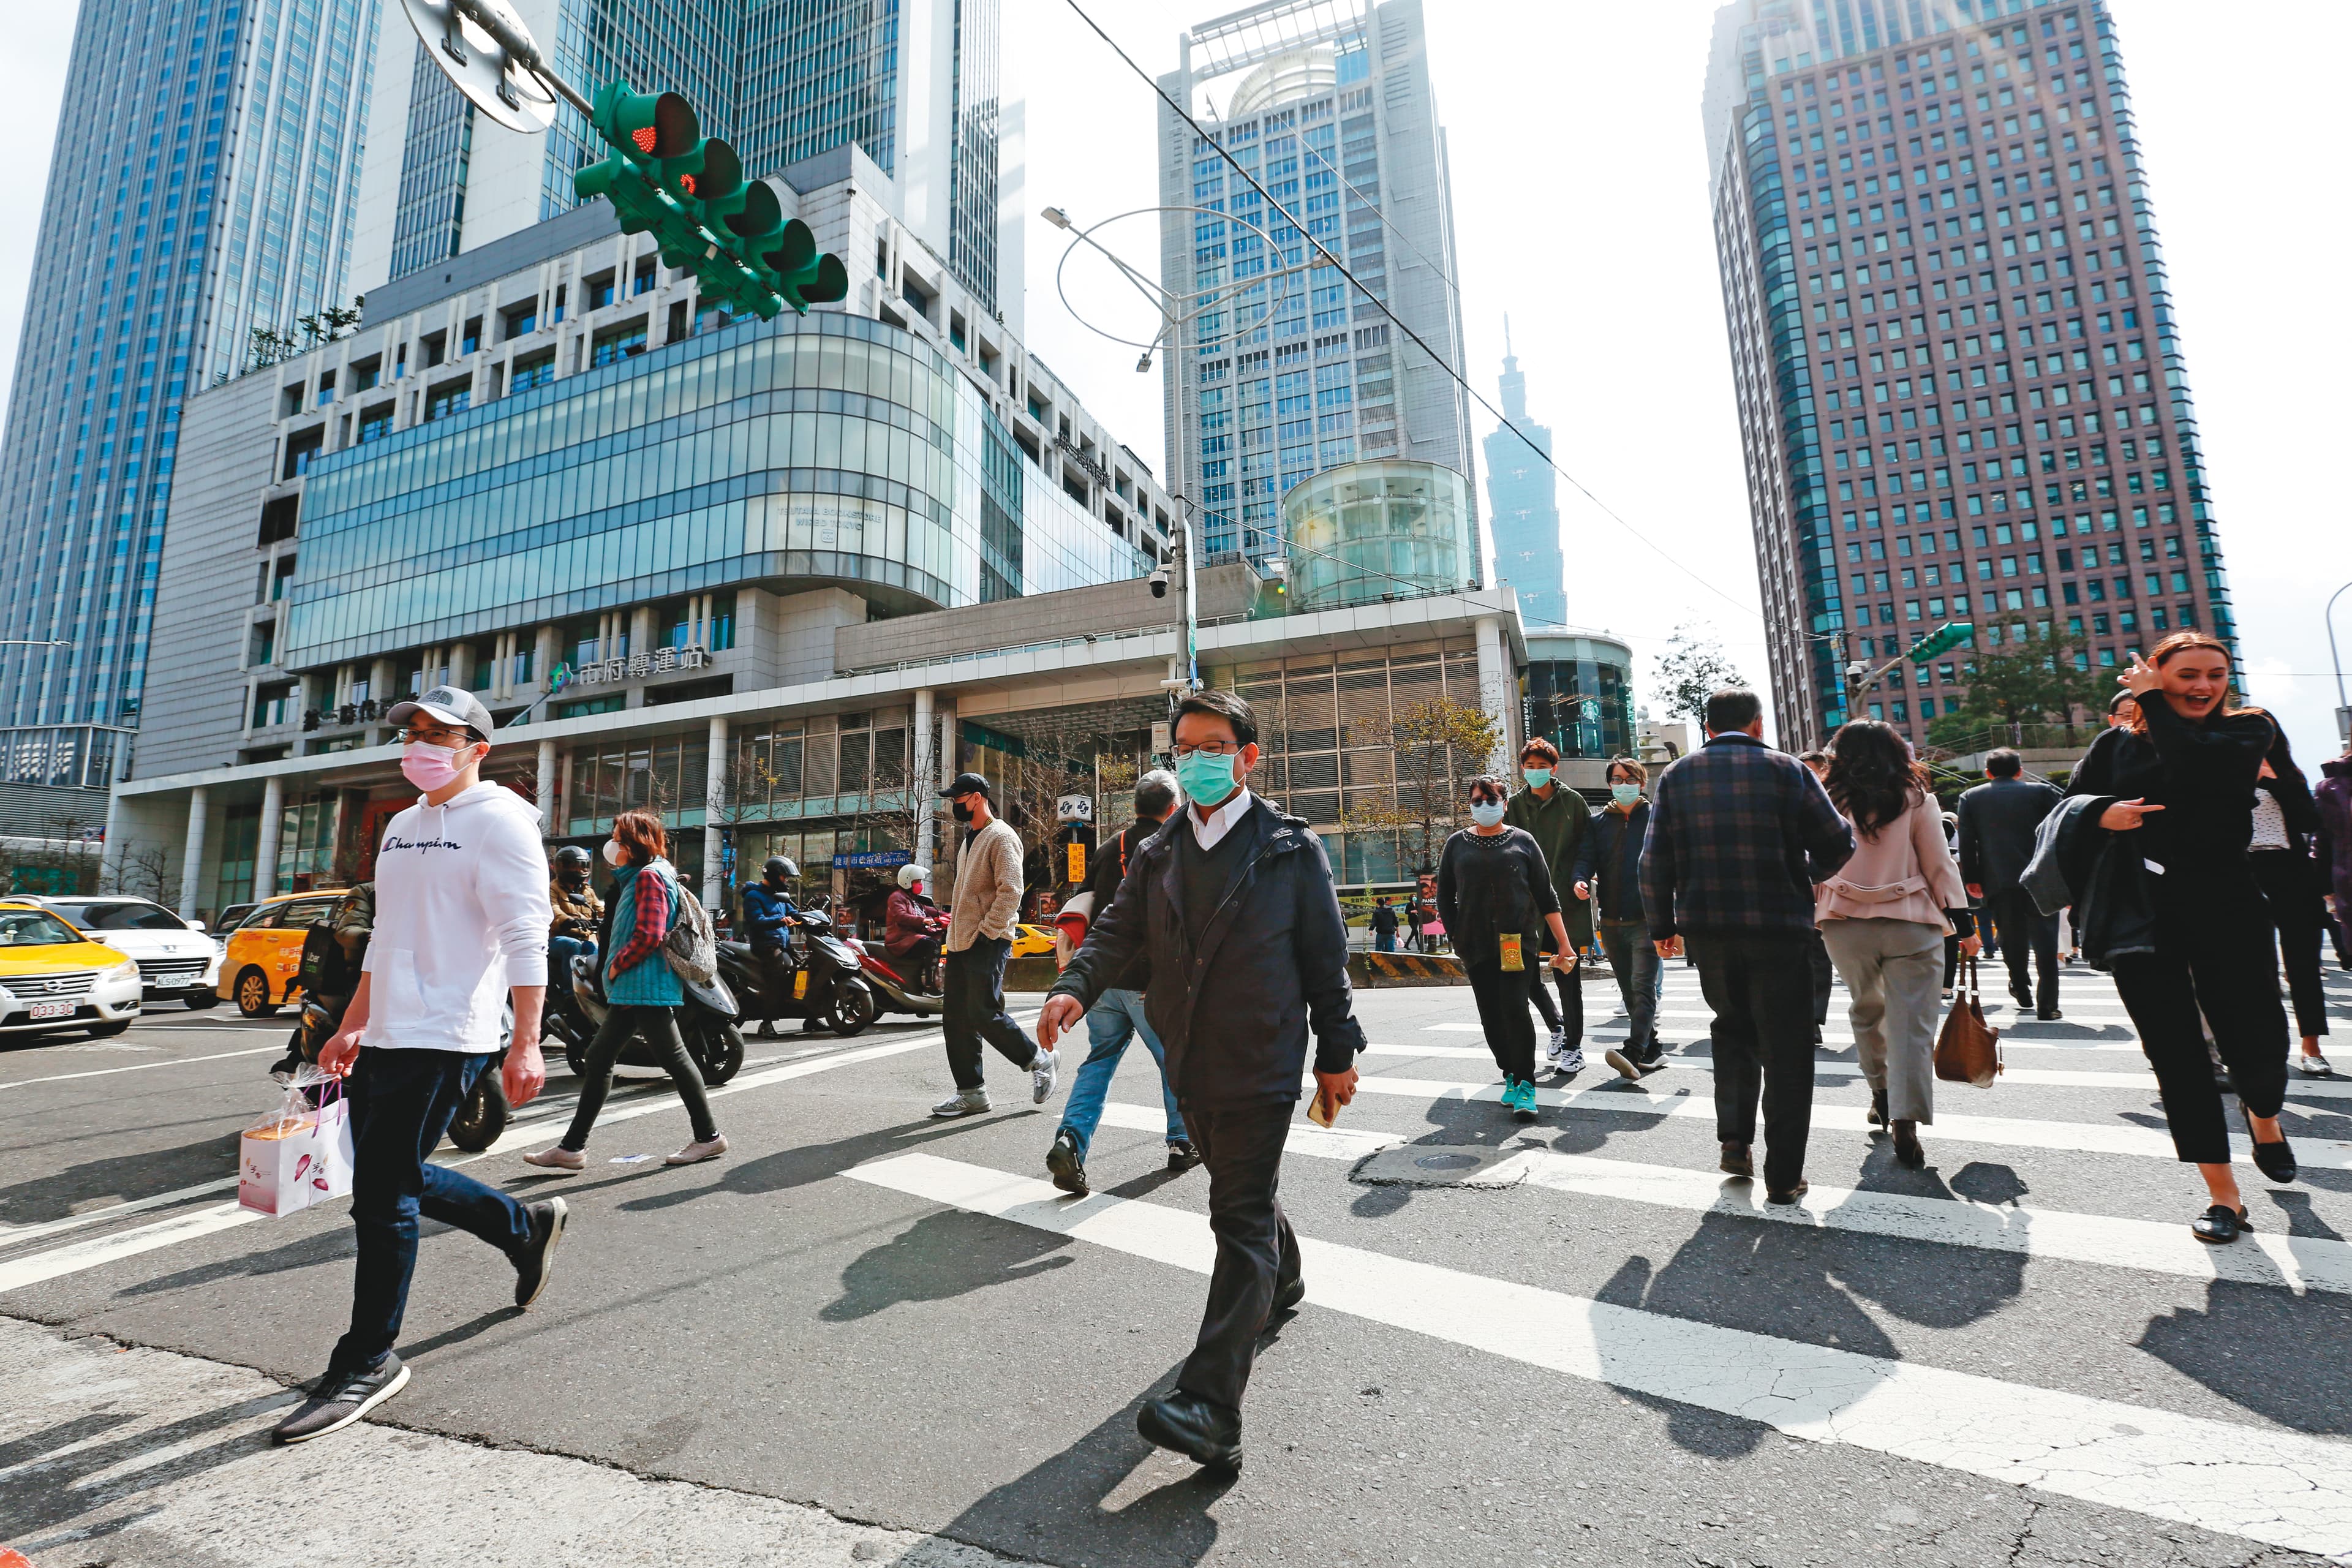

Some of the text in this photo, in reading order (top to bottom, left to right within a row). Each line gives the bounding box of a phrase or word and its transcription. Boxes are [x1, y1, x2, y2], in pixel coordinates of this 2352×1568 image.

[823, 508, 882, 523] BOOKSTORE
[797, 518, 862, 530] WIRED TOKYO
[579, 643, 703, 685] 市府轉運站
[382, 837, 462, 854] Champion
[32, 1003, 74, 1017] 033-3C
